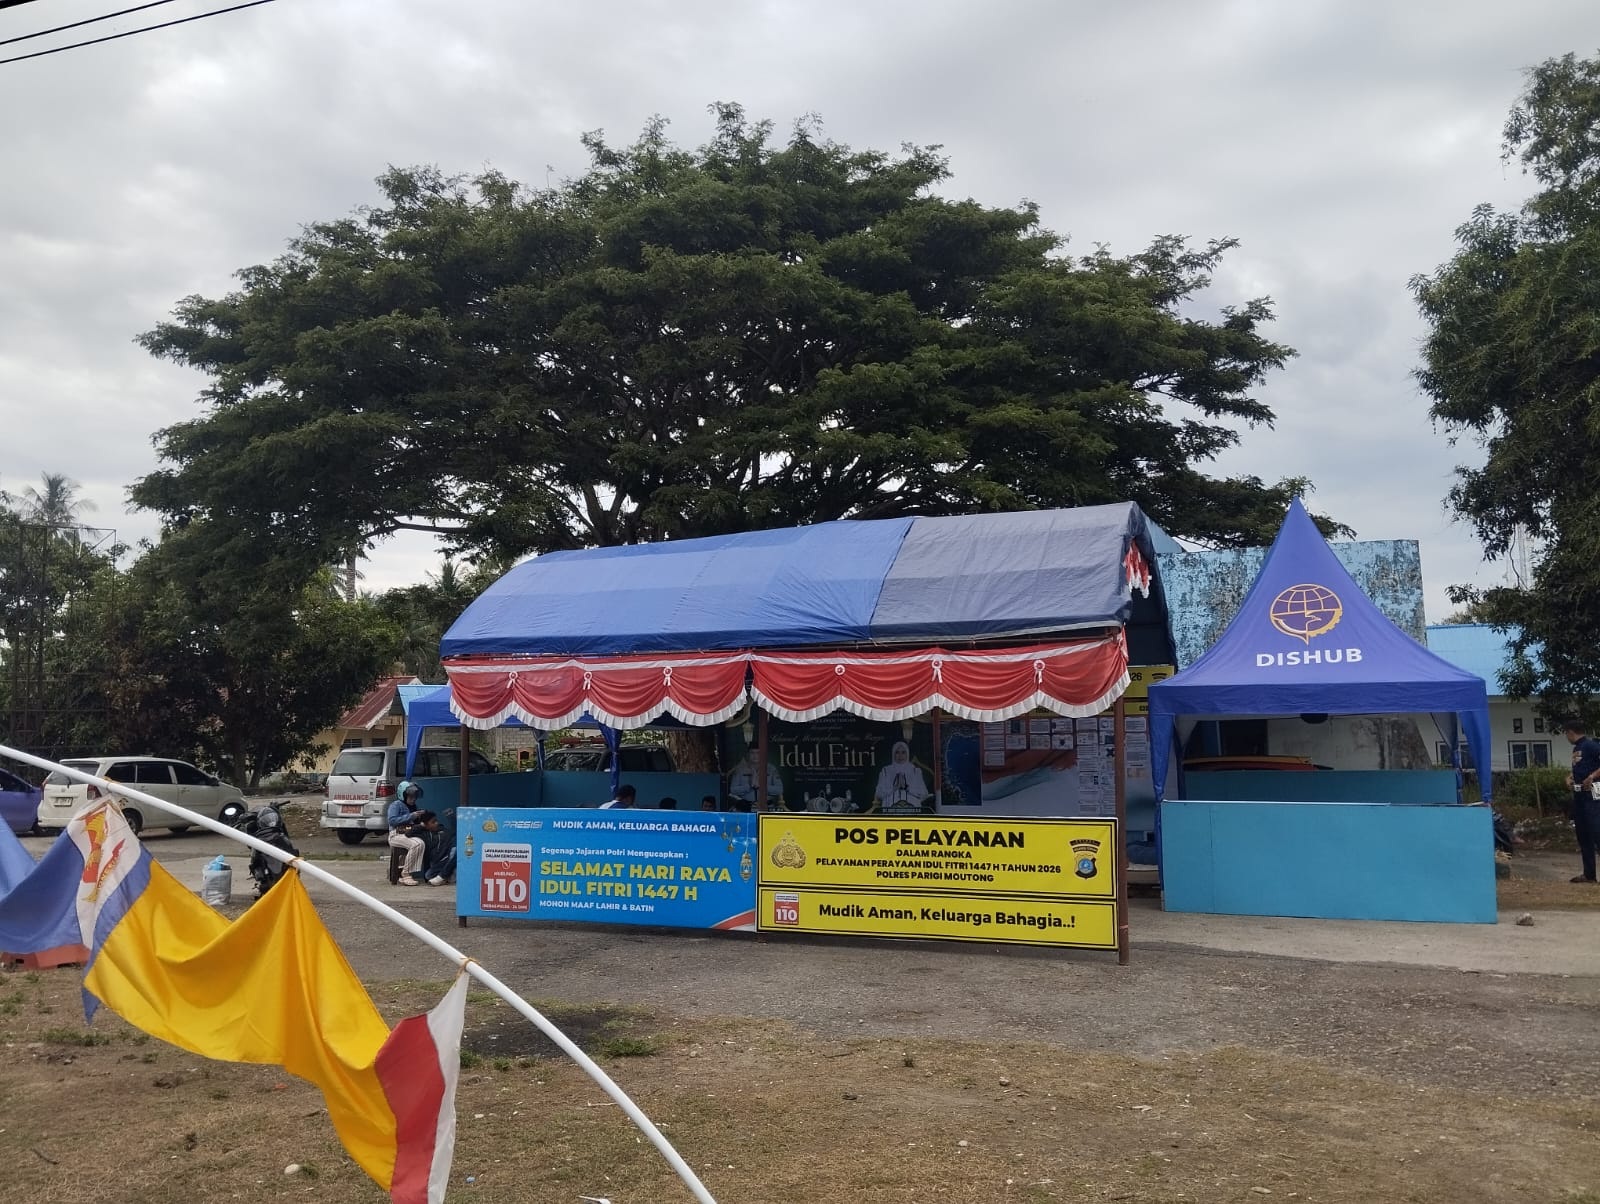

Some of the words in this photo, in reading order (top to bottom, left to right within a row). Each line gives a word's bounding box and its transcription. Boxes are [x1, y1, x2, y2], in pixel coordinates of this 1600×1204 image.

[1256, 648, 1363, 668] DISHUB
[779, 743, 821, 768] Idul
[828, 743, 876, 768] Fitri
[553, 821, 583, 829] MUDIK
[585, 822, 616, 831] AMAN,
[618, 823, 669, 831] KELUARGA
[671, 824, 716, 832] BAHAGIA
[835, 828, 879, 844] POS
[885, 829, 1025, 848] PELAYANAN
[541, 847, 574, 855] Segenap
[576, 848, 605, 856] Jajaran
[627, 850, 684, 859] Mengucapkan
[931, 850, 972, 858] RANGKA
[540, 861, 624, 877] SELAMAT
[629, 864, 675, 880] HARI
[680, 866, 732, 882] RAYA
[816, 858, 869, 867] PELAYANAN
[871, 860, 921, 868] PERAYAAN
[923, 861, 943, 869] IDUL
[945, 862, 968, 870] FITRI
[970, 863, 991, 871] 1447
[993, 863, 999, 871] H
[1001, 864, 1036, 872] TAHUN
[1037, 865, 1061, 873] 2026
[876, 871, 909, 879] POLRES
[911, 872, 942, 880] PARIGI
[944, 873, 994, 882] MOUTONG
[484, 878, 527, 903] 110
[540, 880, 581, 895] IDUL
[586, 882, 631, 897] FITRI
[637, 884, 679, 899] 1447
[684, 886, 697, 901] H
[540, 900, 569, 908] MOHON
[775, 908, 798, 921] 110
[819, 904, 864, 918] Mudik
[868, 906, 917, 921] Aman,
[920, 908, 992, 926] Keluarga
[995, 911, 1075, 930] Bahagia..!
